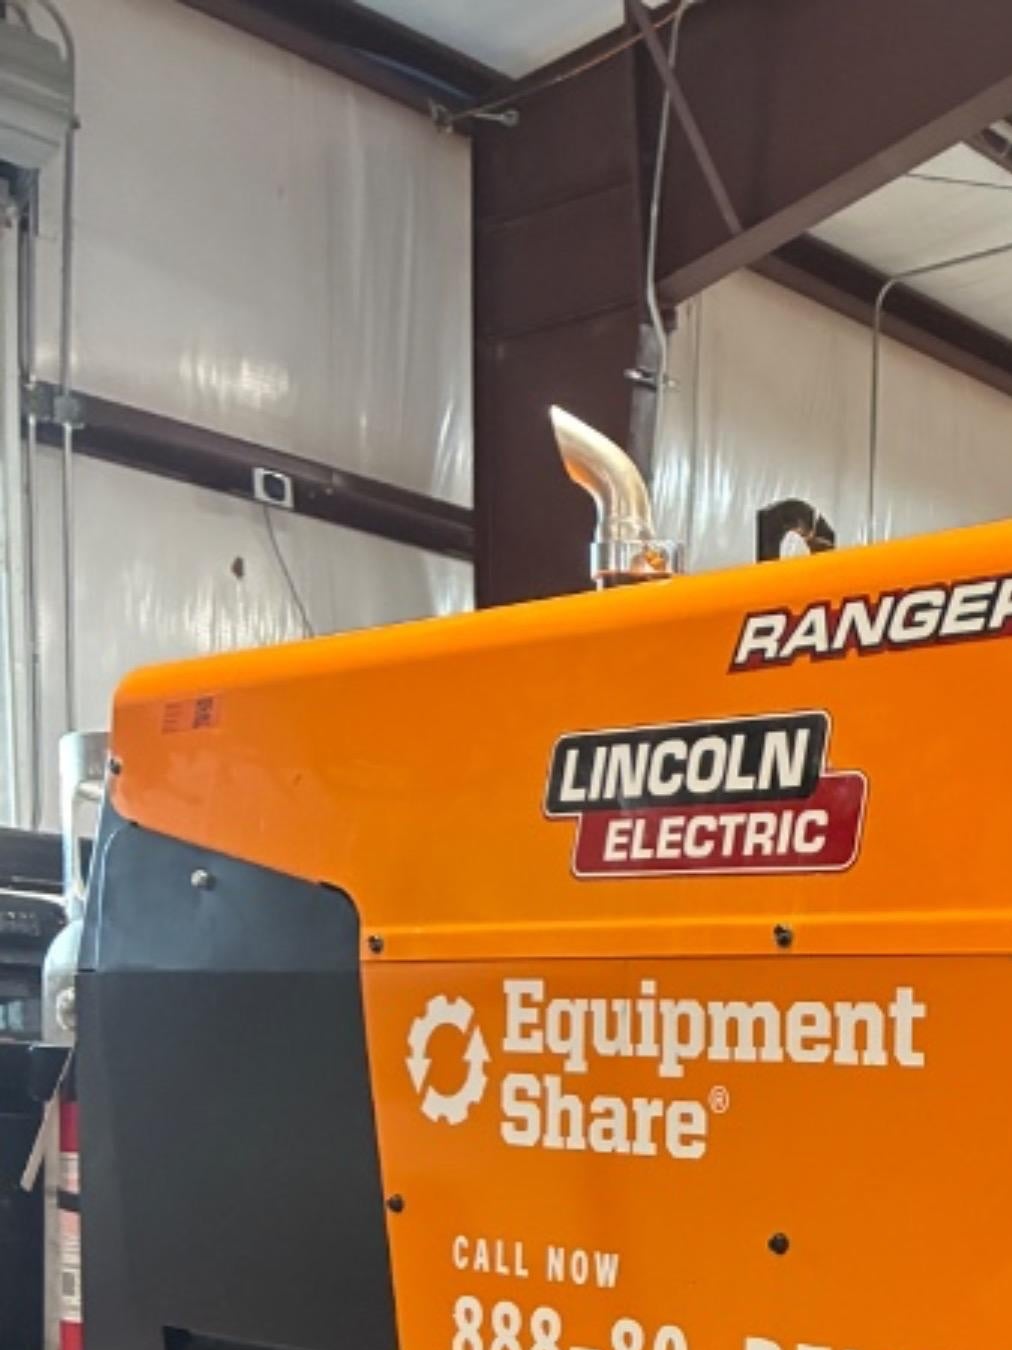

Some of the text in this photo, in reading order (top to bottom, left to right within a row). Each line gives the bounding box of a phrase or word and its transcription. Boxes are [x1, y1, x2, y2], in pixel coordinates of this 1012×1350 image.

[559, 729, 810, 802] LINCOLN
[603, 809, 829, 862] ELECTRIC
[502, 978, 926, 1077] Equipment
[452, 1234, 619, 1288] CALL NOW
